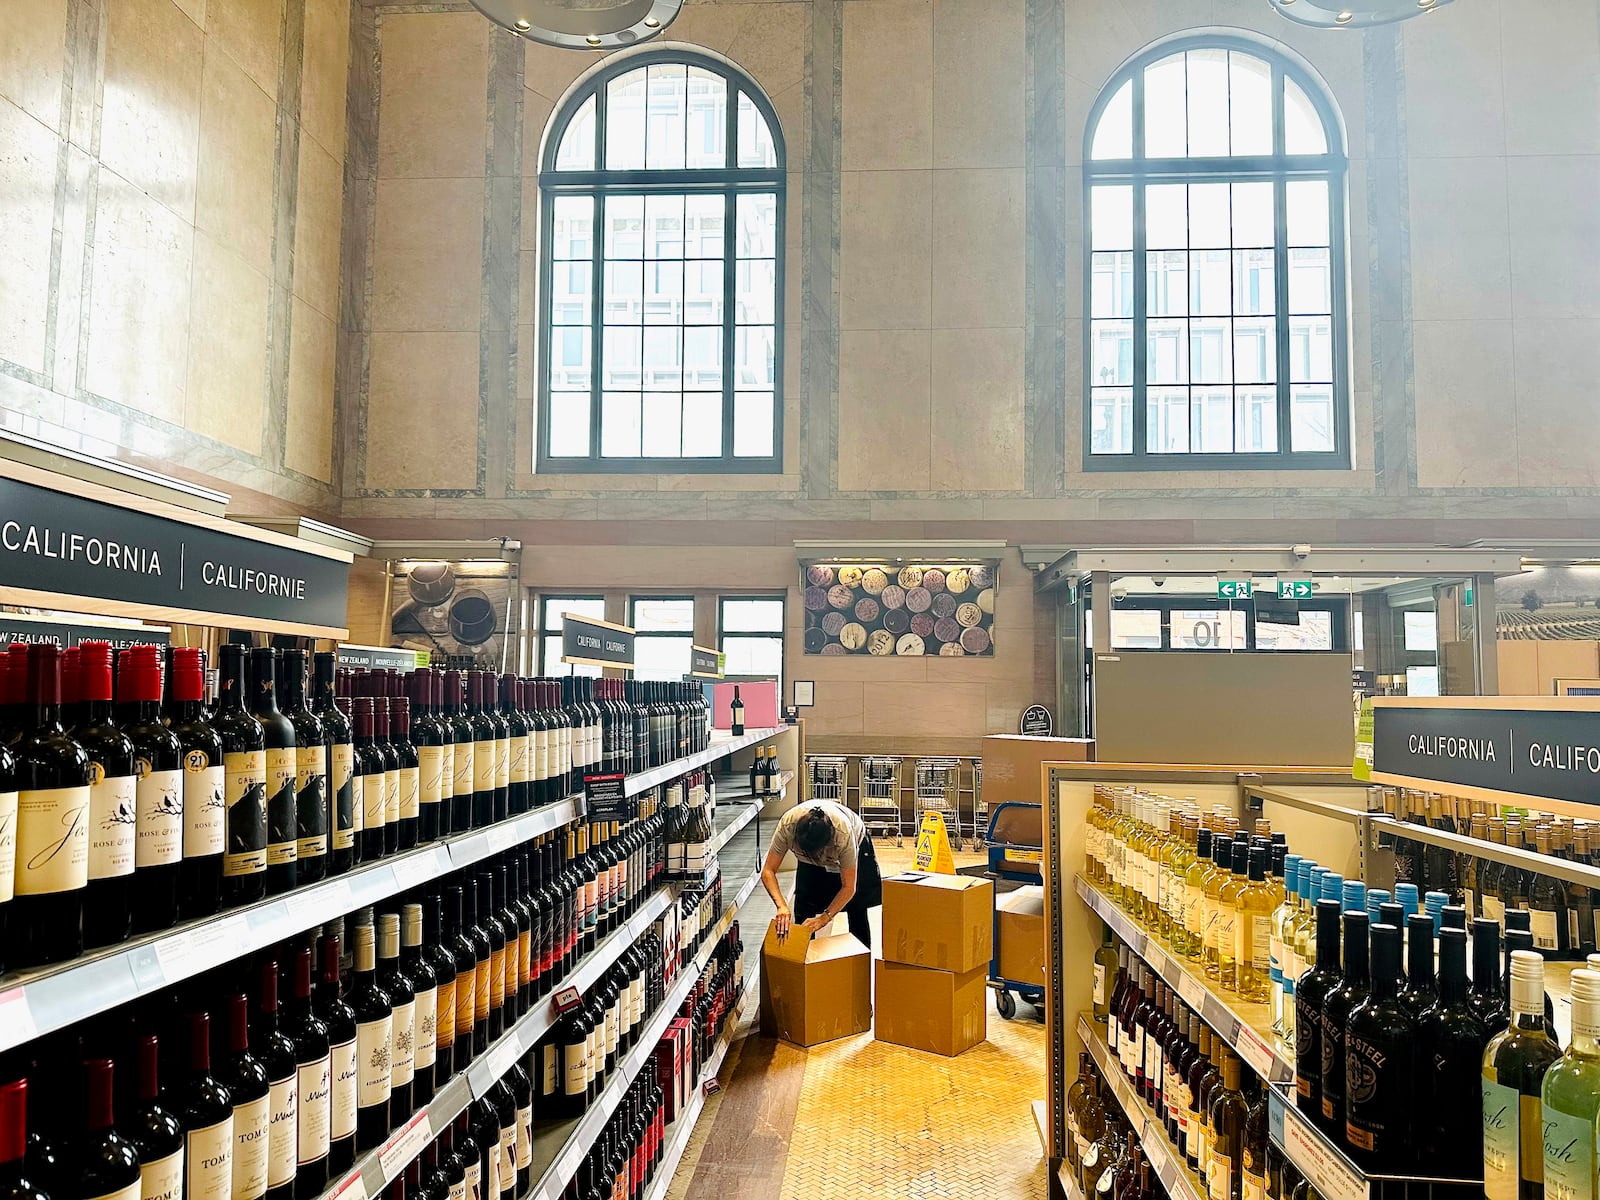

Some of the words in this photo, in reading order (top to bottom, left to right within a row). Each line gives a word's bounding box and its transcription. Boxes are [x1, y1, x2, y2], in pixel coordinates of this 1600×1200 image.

[2, 519, 162, 577] CALIFORNIA
[202, 561, 306, 600] CALIFORNIE
[1408, 733, 1497, 763] CALIFORNIA
[1529, 742, 1600, 774] CALIFO
[238, 1129, 261, 1143] TOM
[201, 1153, 225, 1169] TOM
